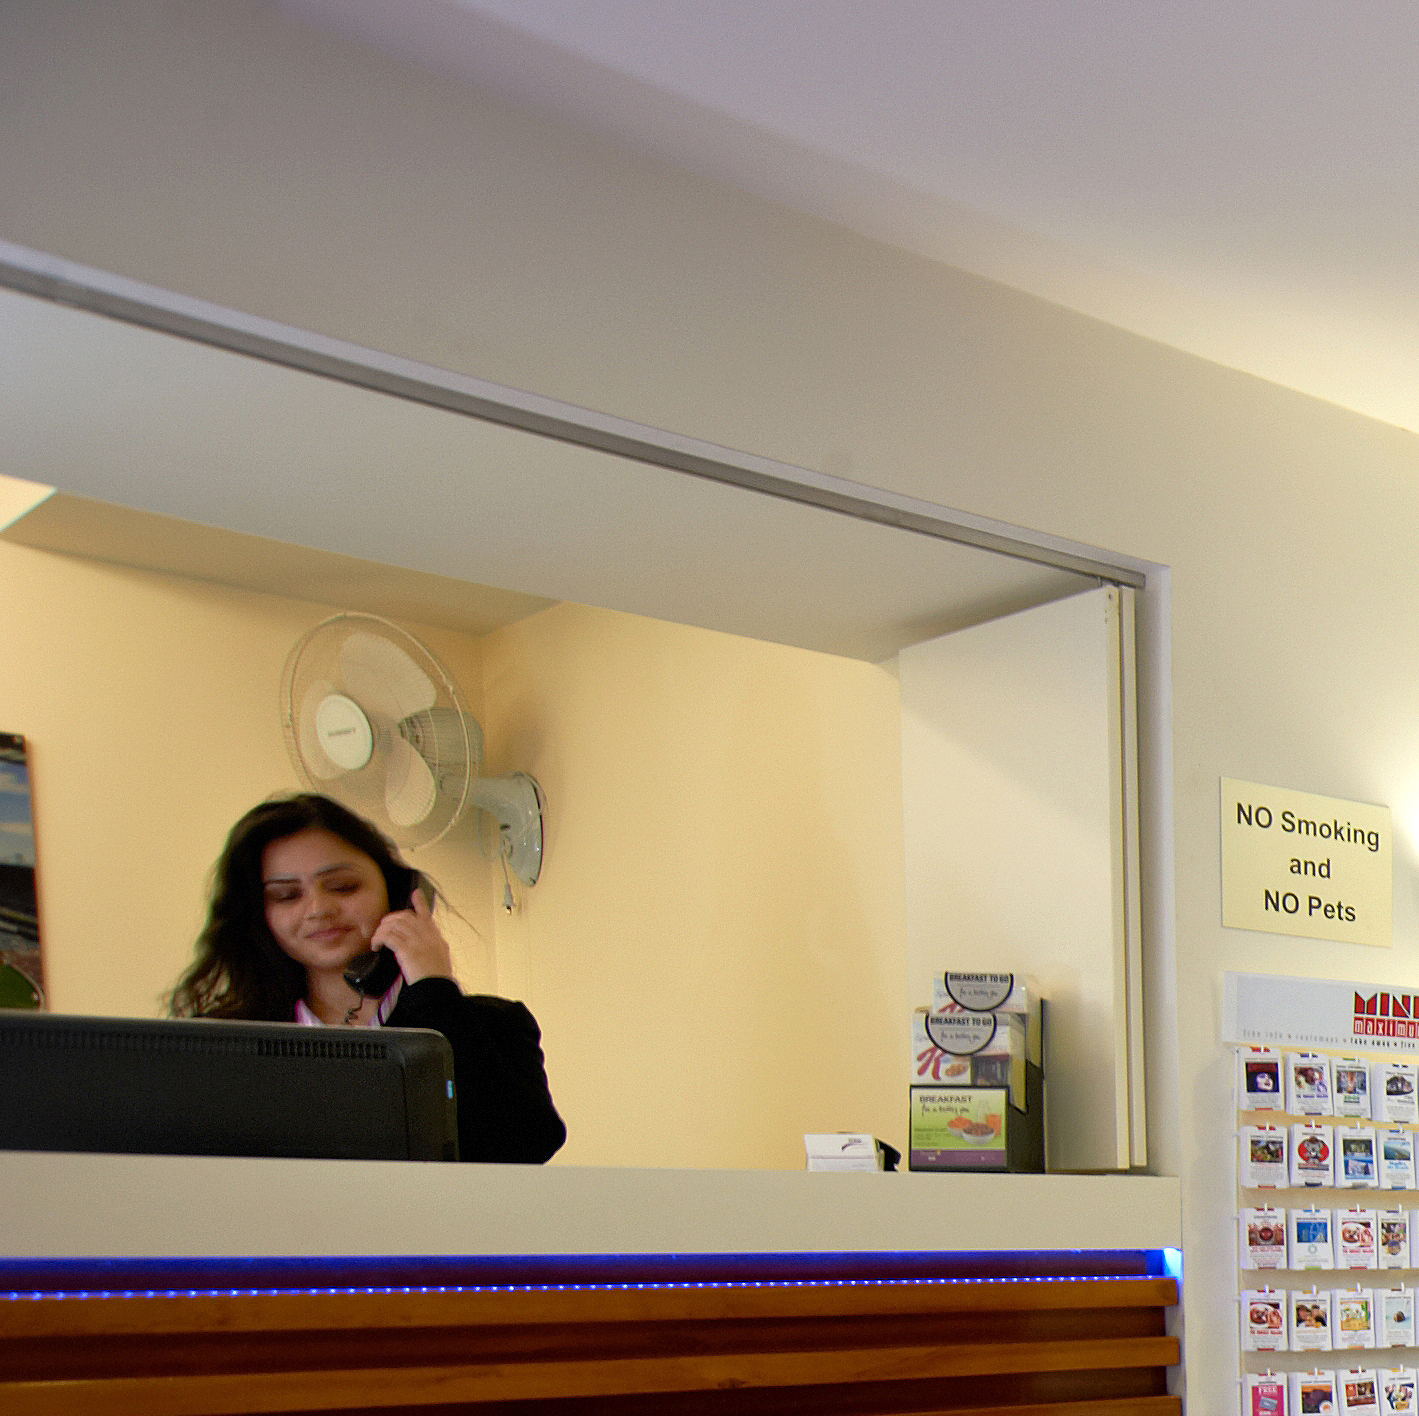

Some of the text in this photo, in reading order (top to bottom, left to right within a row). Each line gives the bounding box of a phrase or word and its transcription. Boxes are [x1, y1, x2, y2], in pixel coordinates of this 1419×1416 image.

[1236, 802, 1380, 852] NO Smoking
[1289, 857, 1332, 879] and
[1264, 889, 1357, 922] NO Pets
[949, 973, 987, 982] BREAKFAST
[930, 1016, 969, 1026] BREAKFAST
[972, 1017, 981, 1026] TO
[919, 1094, 973, 1103] BREAKFAST
